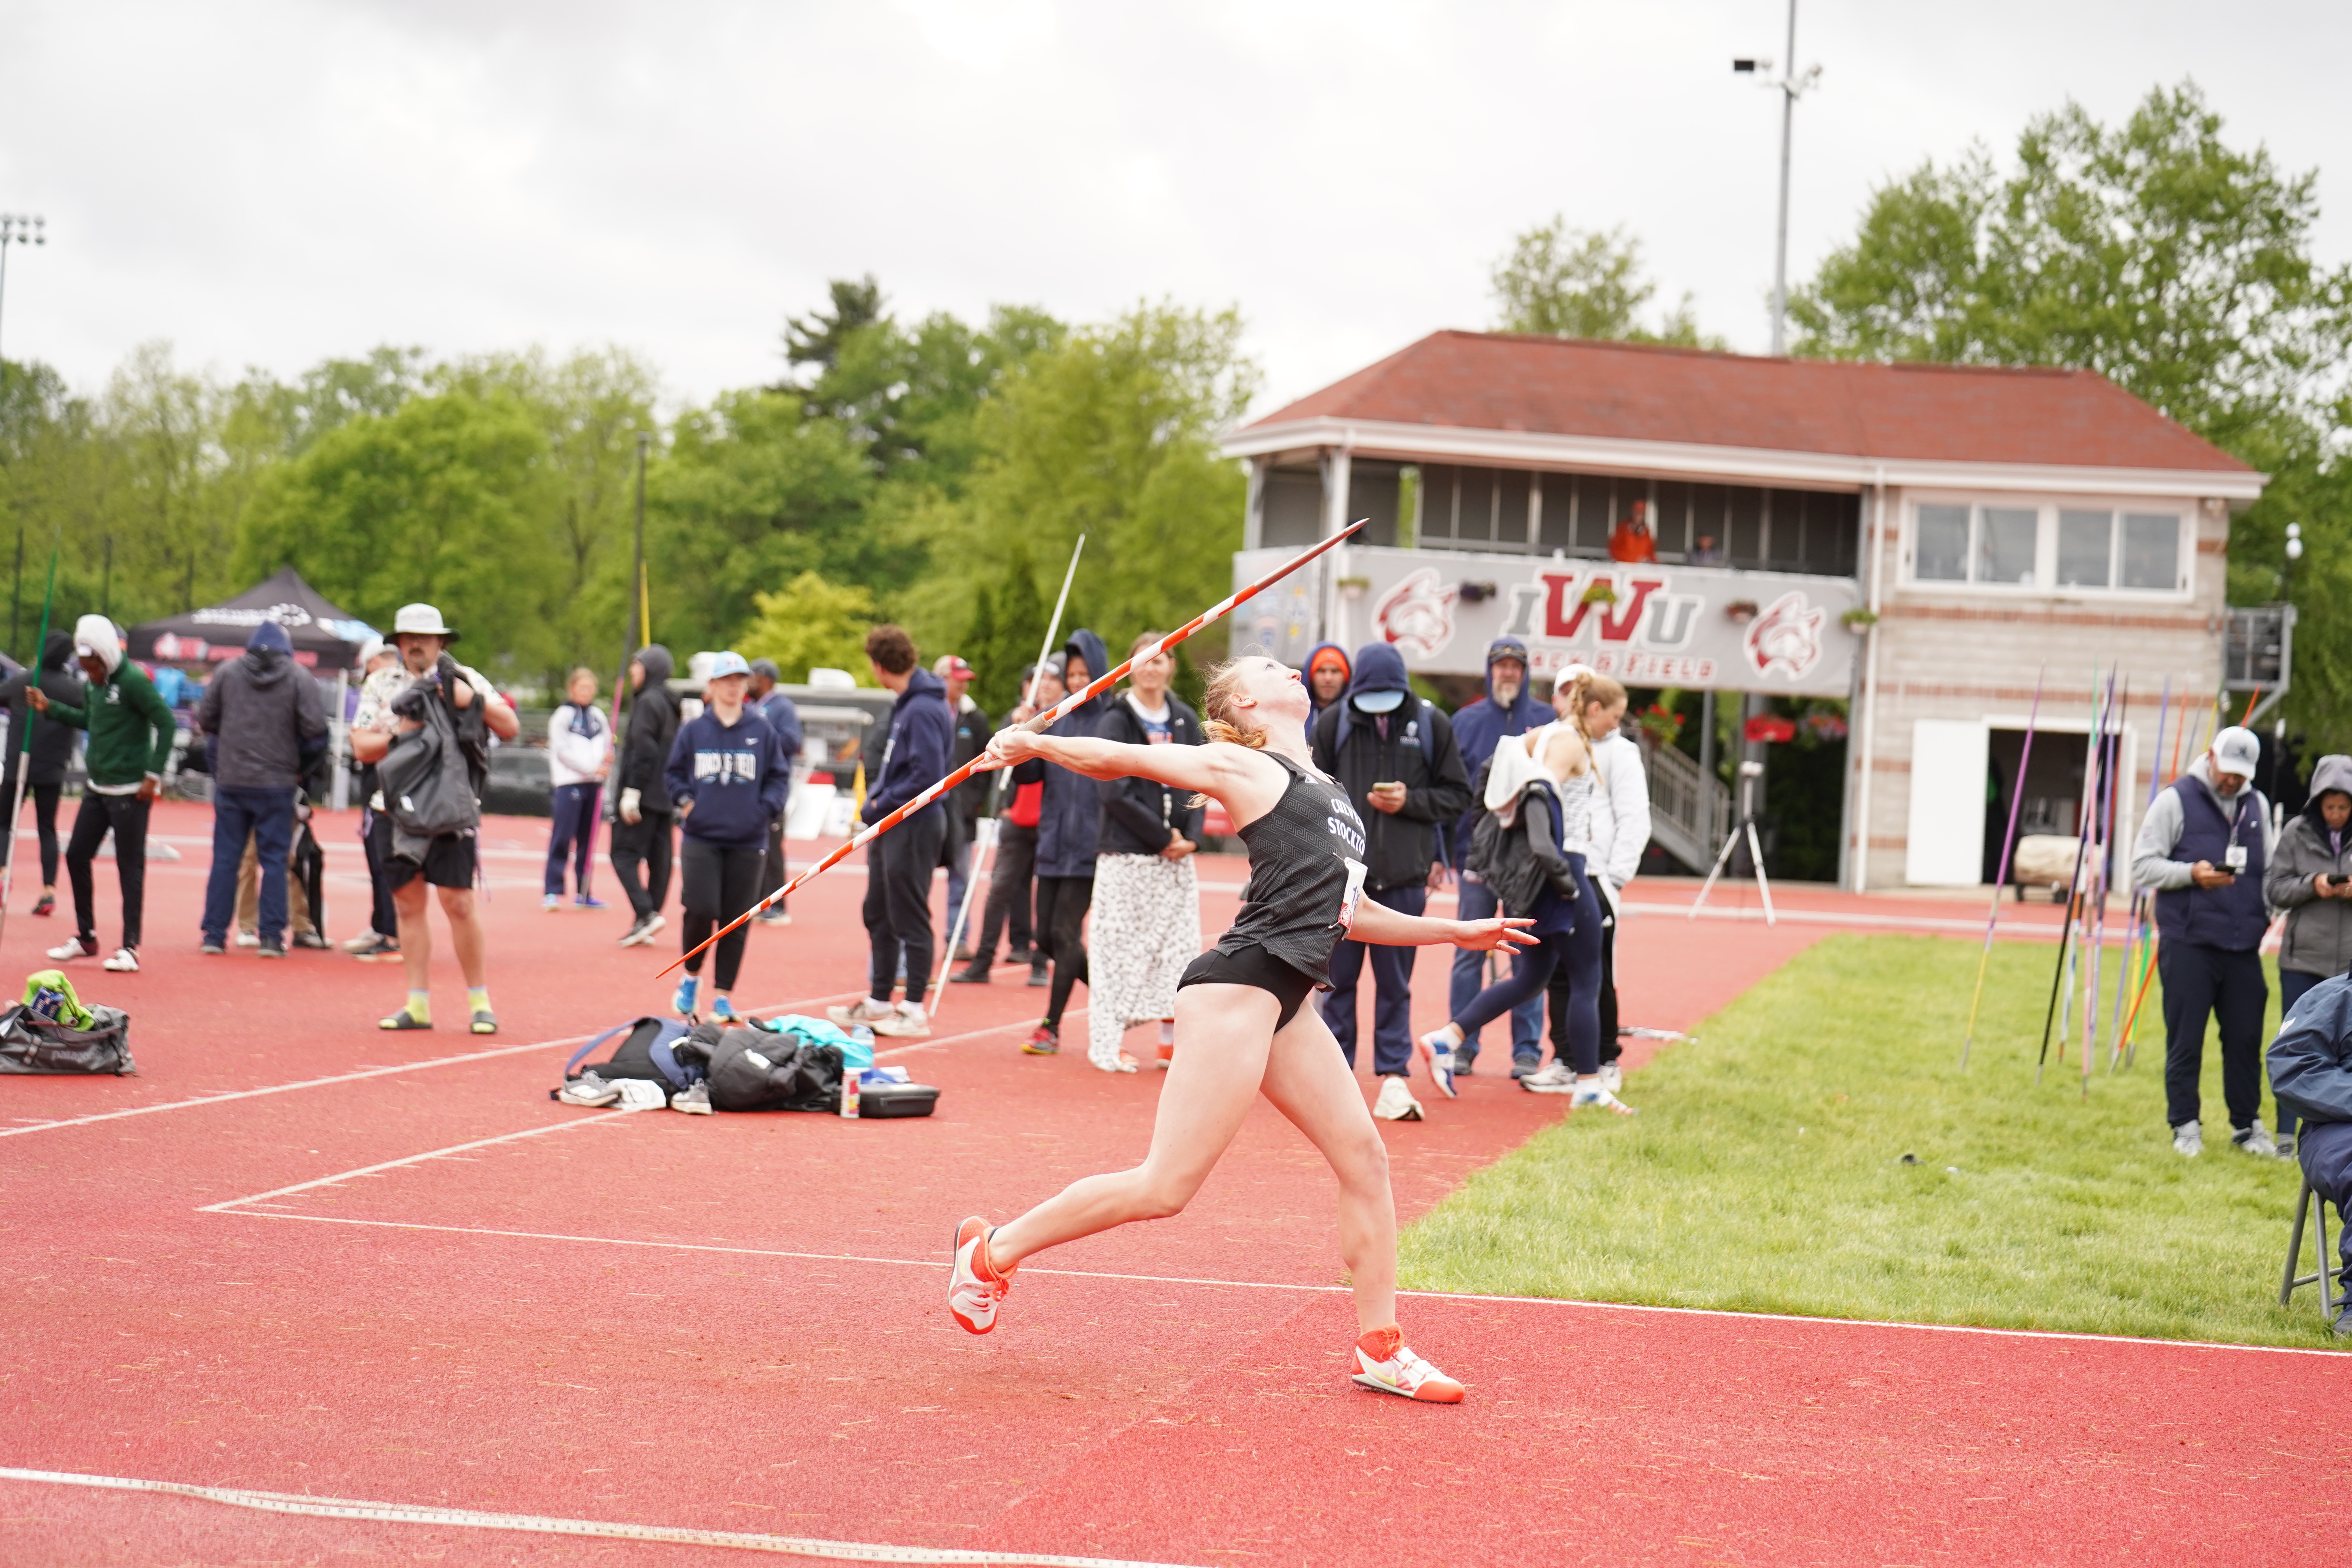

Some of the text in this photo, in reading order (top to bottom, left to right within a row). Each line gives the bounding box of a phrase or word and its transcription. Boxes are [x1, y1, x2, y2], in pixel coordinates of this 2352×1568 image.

[1507, 572, 1699, 645] IWU
[1626, 652, 1713, 679] FIELD
[1327, 817, 1365, 856] STOCKTO
